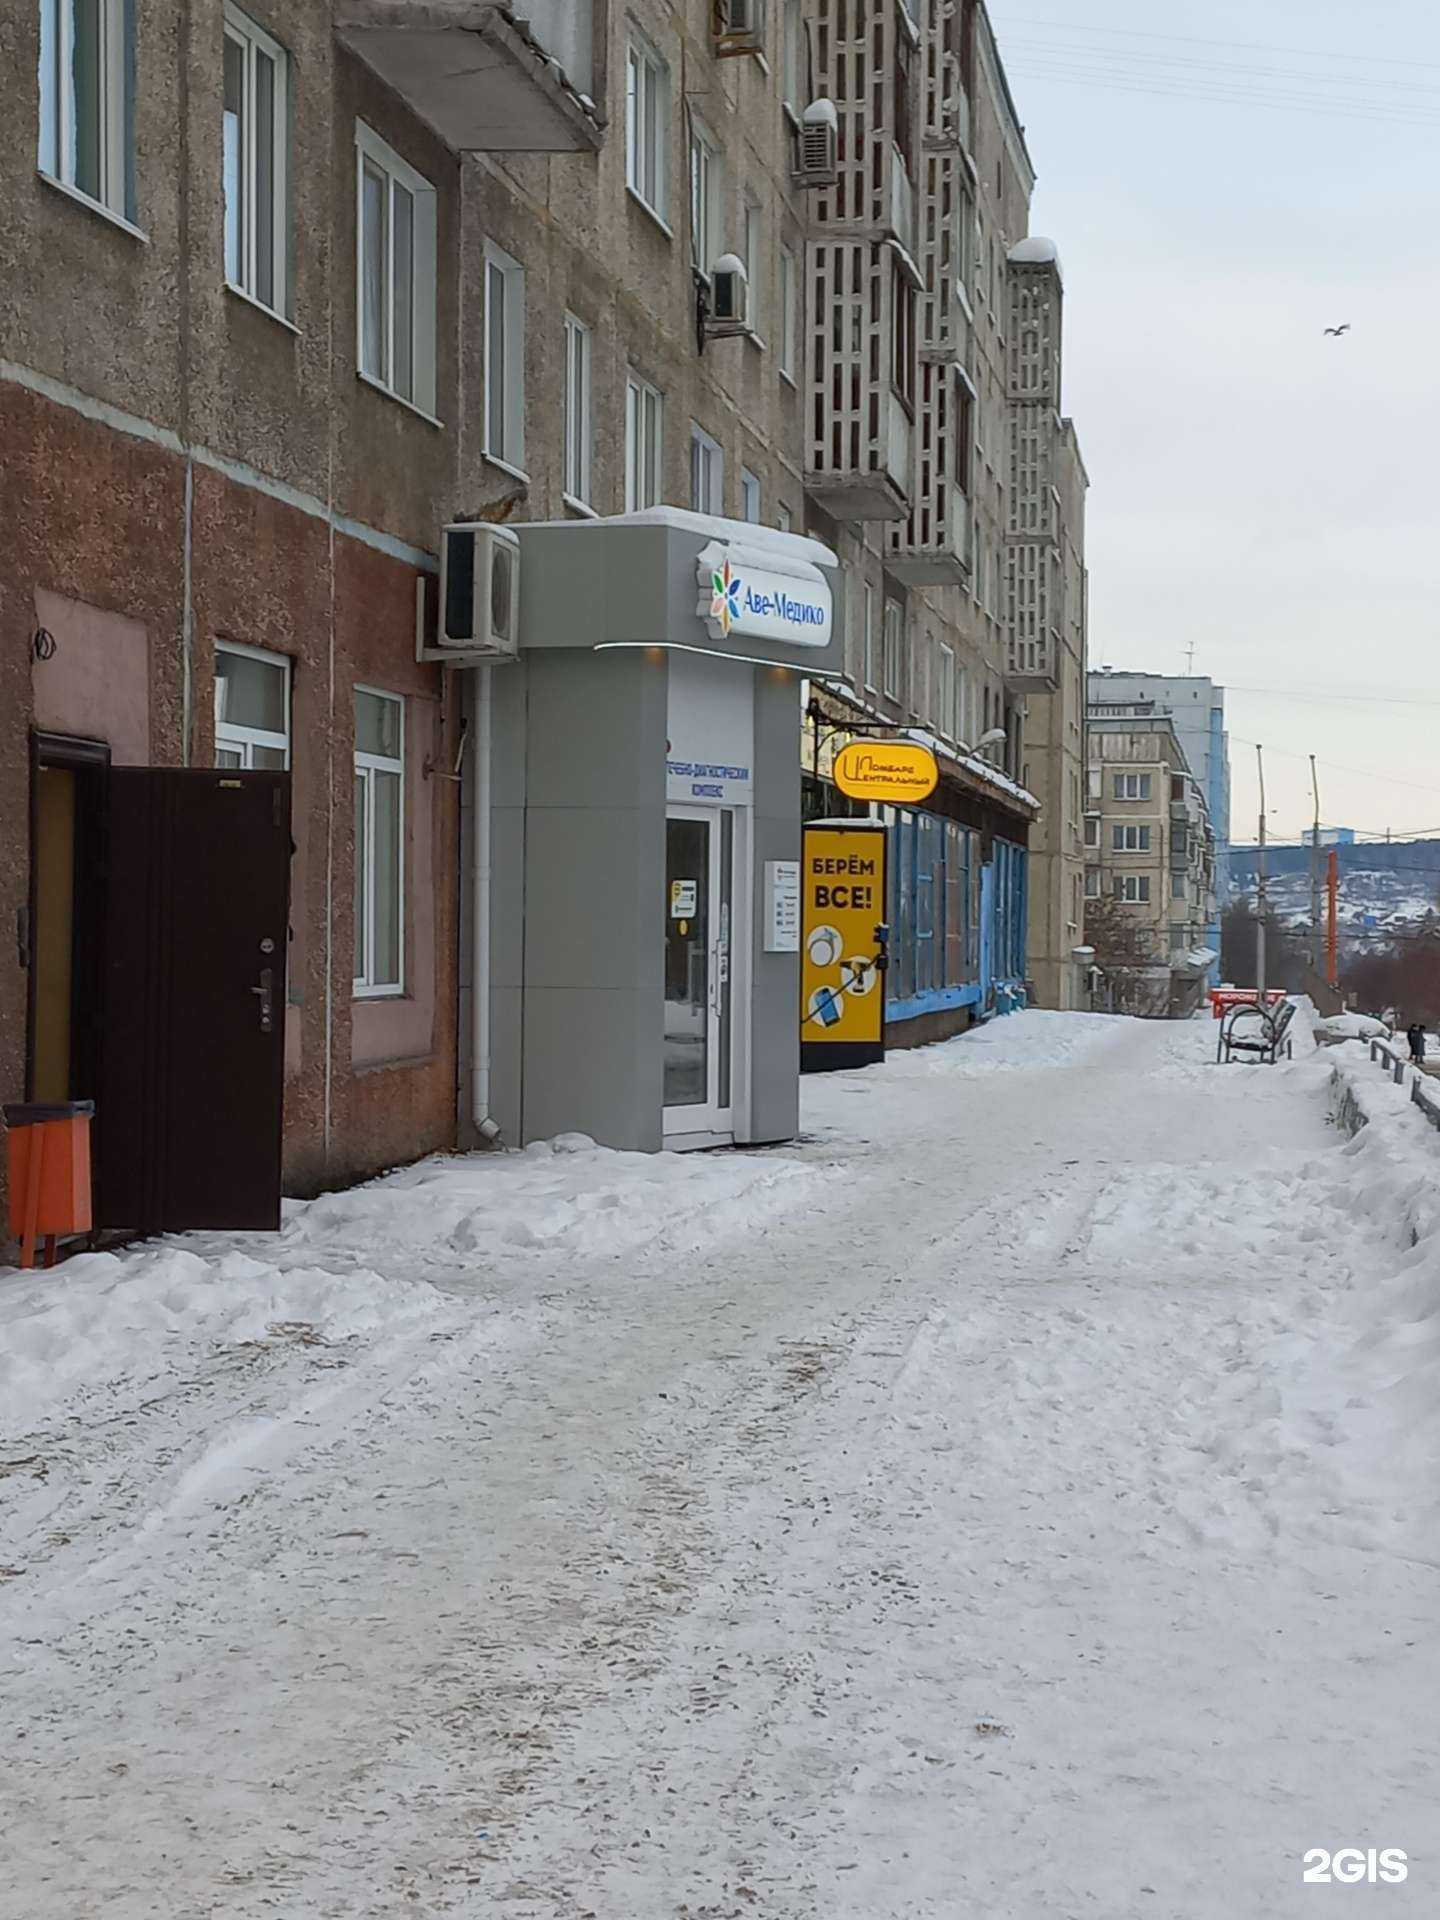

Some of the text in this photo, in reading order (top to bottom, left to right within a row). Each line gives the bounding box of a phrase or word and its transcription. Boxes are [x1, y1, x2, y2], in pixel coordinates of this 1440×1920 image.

[743, 586, 825, 625] Аве-Медико
[812, 854, 875, 876] БЕРЁМ
[815, 885, 872, 909] ВСЕ!
